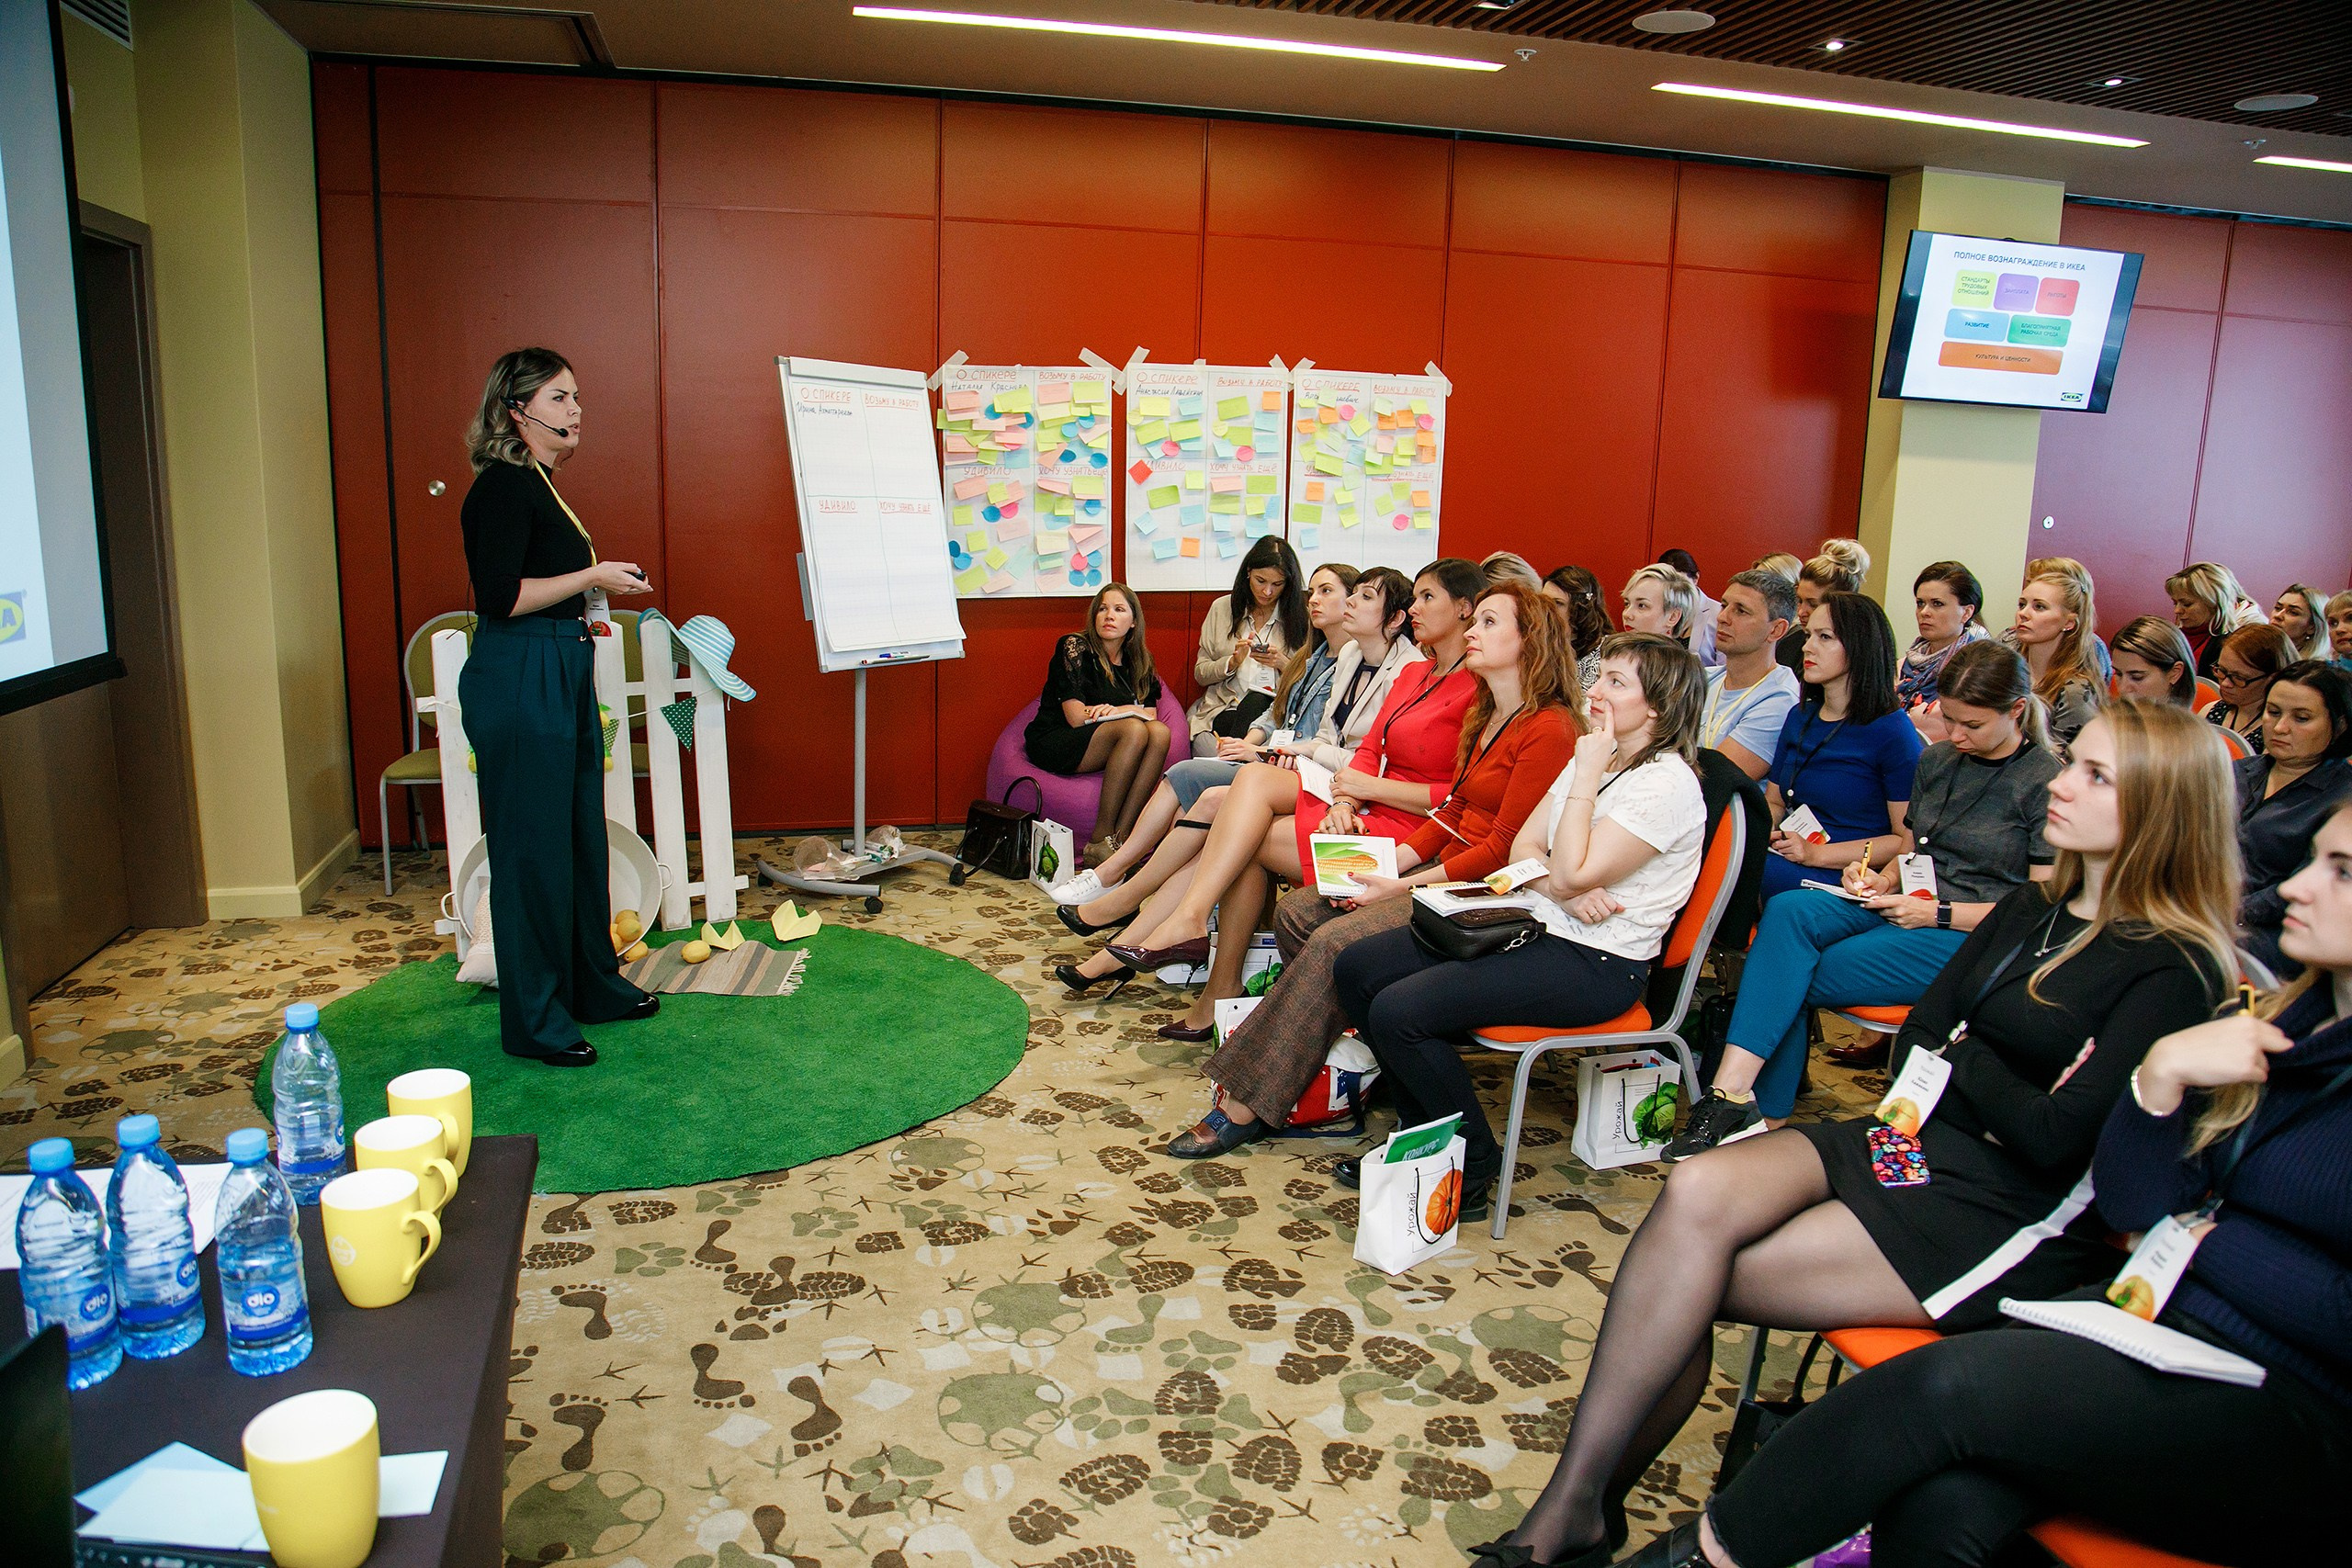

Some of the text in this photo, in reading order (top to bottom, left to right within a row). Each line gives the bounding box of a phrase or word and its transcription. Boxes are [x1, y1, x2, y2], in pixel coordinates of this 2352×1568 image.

[1953, 251, 1986, 262] ПОЛНОЕ
[1988, 254, 2058, 269] ВОЗНАГРАЖДЕНИЕ
[2066, 263, 2086, 271] ИКЕА
[1612, 1100, 1623, 1140] Урожай
[1407, 1192, 1417, 1236] Урожай
